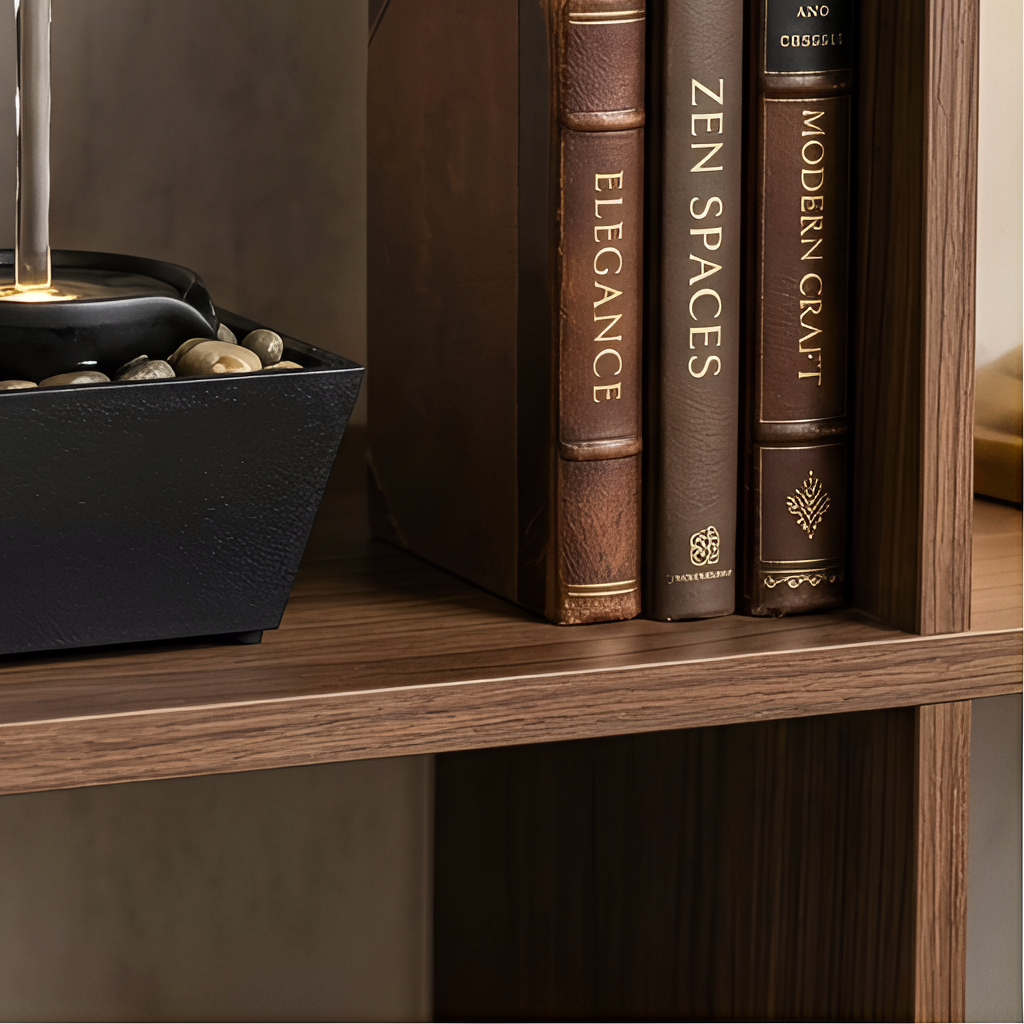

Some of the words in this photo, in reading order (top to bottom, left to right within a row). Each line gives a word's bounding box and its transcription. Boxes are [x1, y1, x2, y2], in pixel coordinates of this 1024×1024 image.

[689, 78, 724, 173] ZEN
[800, 109, 825, 261] MODERN
[592, 170, 624, 404] ELEGANCE
[687, 195, 724, 379] SPACES
